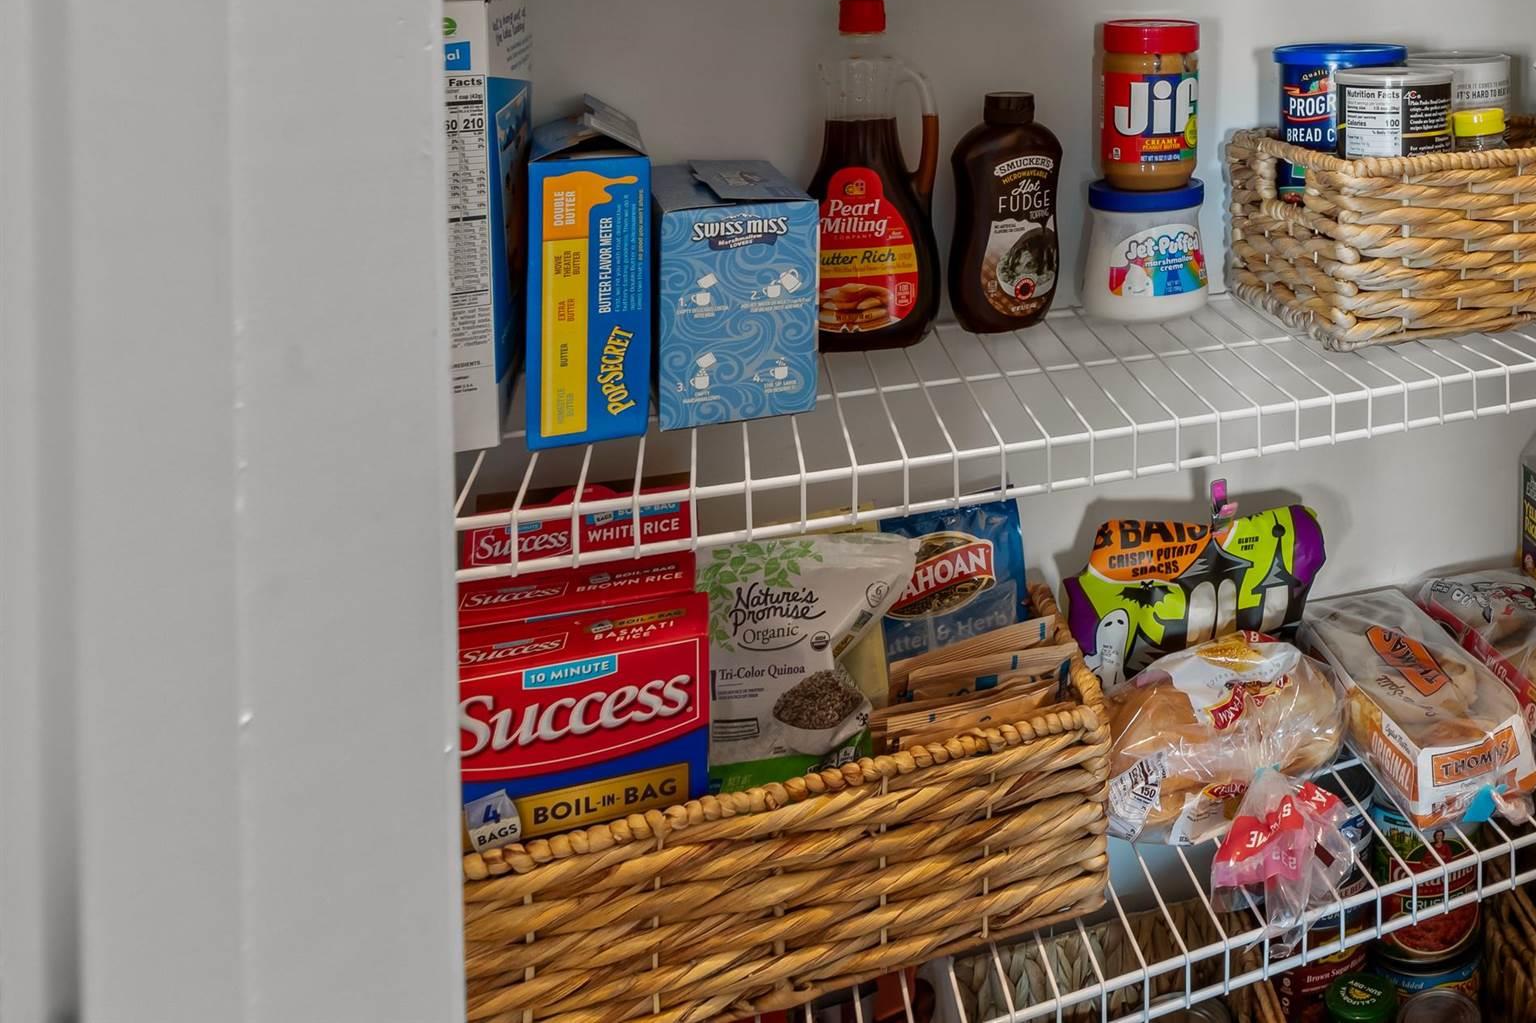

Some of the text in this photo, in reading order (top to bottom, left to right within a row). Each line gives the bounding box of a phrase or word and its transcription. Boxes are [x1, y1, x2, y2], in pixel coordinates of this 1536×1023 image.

[449, 78, 483, 87] Facts
[1289, 93, 1336, 116] PROGR
[1347, 89, 1376, 100] Nutrition
[1471, 89, 1489, 99] HARD
[1114, 77, 1198, 136] Jif
[463, 118, 484, 129] 210
[1385, 119, 1400, 127] 100
[1287, 127, 1322, 142] BREAD
[999, 158, 1052, 175] SMUCKER'S
[1012, 179, 1040, 195] Hot
[554, 190, 564, 226] DOUBLE
[565, 190, 576, 225] BUTTER
[828, 199, 880, 216] Pearl
[999, 190, 1050, 214] FUDGE
[693, 217, 787, 241] SWISS MISS
[820, 217, 888, 238] Milling
[861, 249, 896, 265] Rich
[1125, 232, 1199, 260] Jet-Puffed
[554, 255, 562, 276] MOVIE
[598, 216, 612, 314] BUTTER FLAVOR METER
[1160, 263, 1184, 272] creme
[567, 298, 575, 322] BUTTER
[560, 343, 568, 368] BUTTER
[643, 518, 680, 536] RICE
[1238, 536, 1259, 544] GLUTEN
[1108, 544, 1198, 569] CRISPY POTATO
[576, 572, 684, 593] BROWN RICE
[901, 547, 987, 601] AHOAN
[464, 586, 562, 608] Success
[735, 582, 819, 610] Nature's
[729, 602, 826, 637] Promise
[593, 620, 674, 642] BASMATI
[616, 631, 651, 642] RICE
[743, 623, 799, 645] Organic
[459, 639, 562, 665] Success
[531, 660, 610, 684] 10 MINUTE
[719, 664, 805, 681] Tri-Color Quinoa
[460, 674, 691, 758] Success
[1372, 733, 1412, 785] ORIGINAL
[482, 804, 501, 824] 4
[477, 823, 518, 846] BAGS
